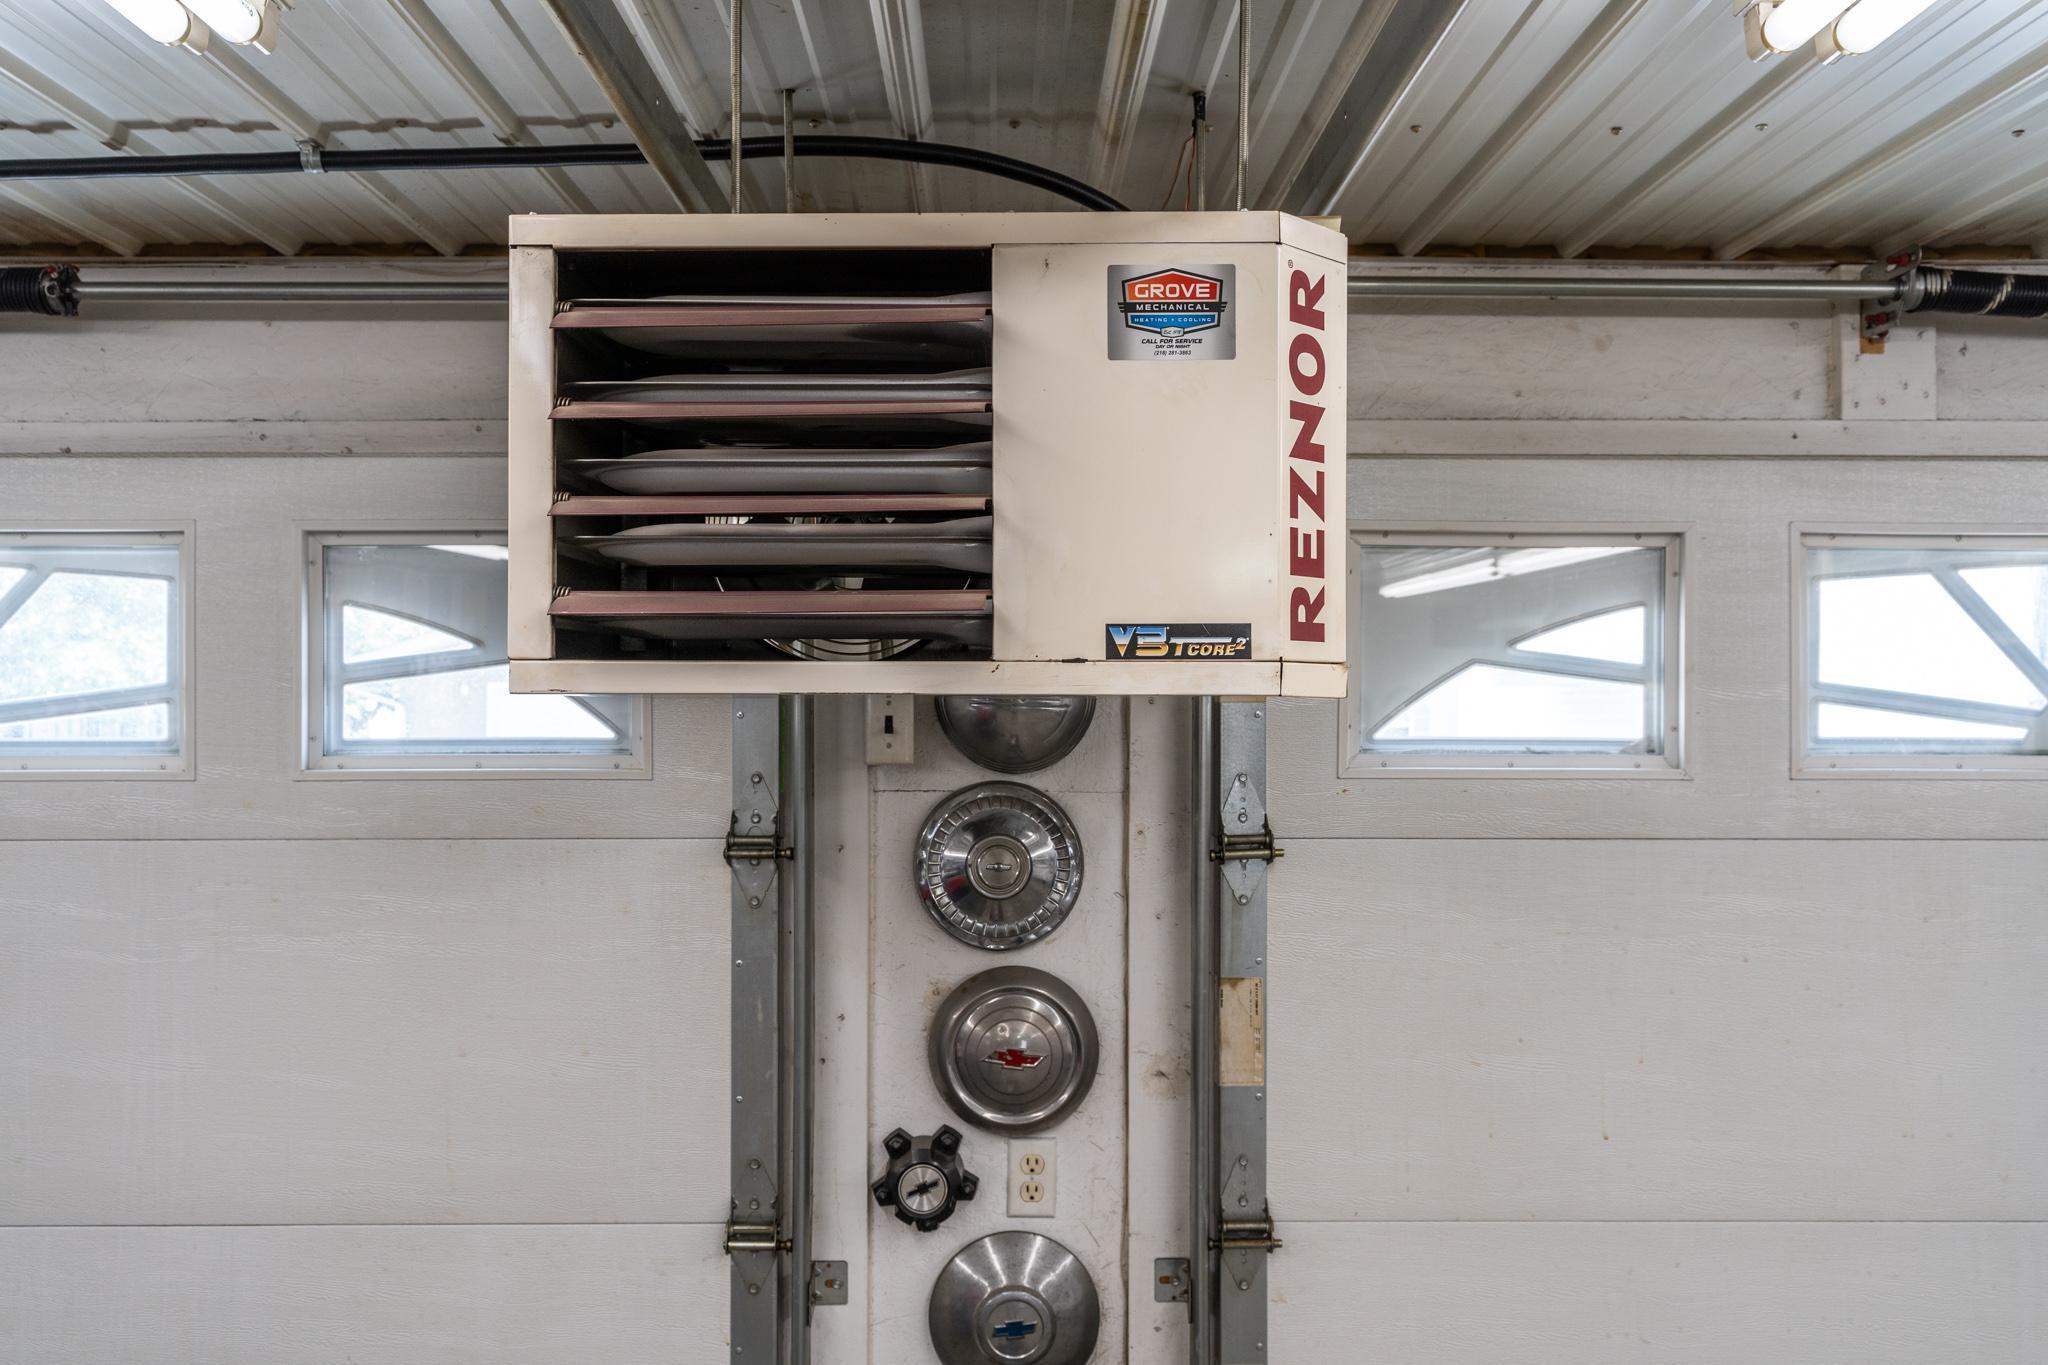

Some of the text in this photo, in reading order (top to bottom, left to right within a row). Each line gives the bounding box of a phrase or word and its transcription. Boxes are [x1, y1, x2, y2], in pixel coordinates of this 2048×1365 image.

[1135, 284, 1210, 298] GROVE
[1289, 269, 1325, 643] REZNOR
[1108, 626, 1169, 656] V3
